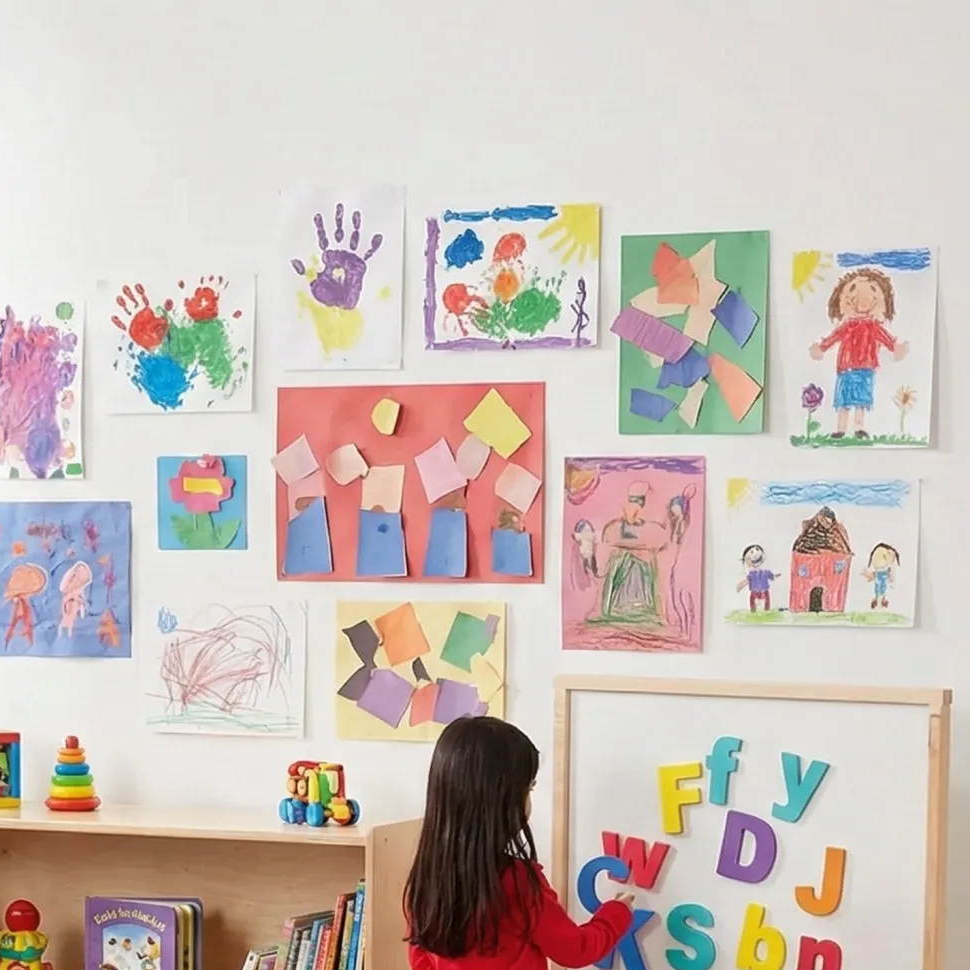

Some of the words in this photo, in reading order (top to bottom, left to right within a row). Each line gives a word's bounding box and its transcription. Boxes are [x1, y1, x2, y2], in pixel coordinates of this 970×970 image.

[658, 762, 702, 834] F
[705, 735, 744, 806] f
[716, 810, 777, 884] D
[795, 847, 846, 917] J
